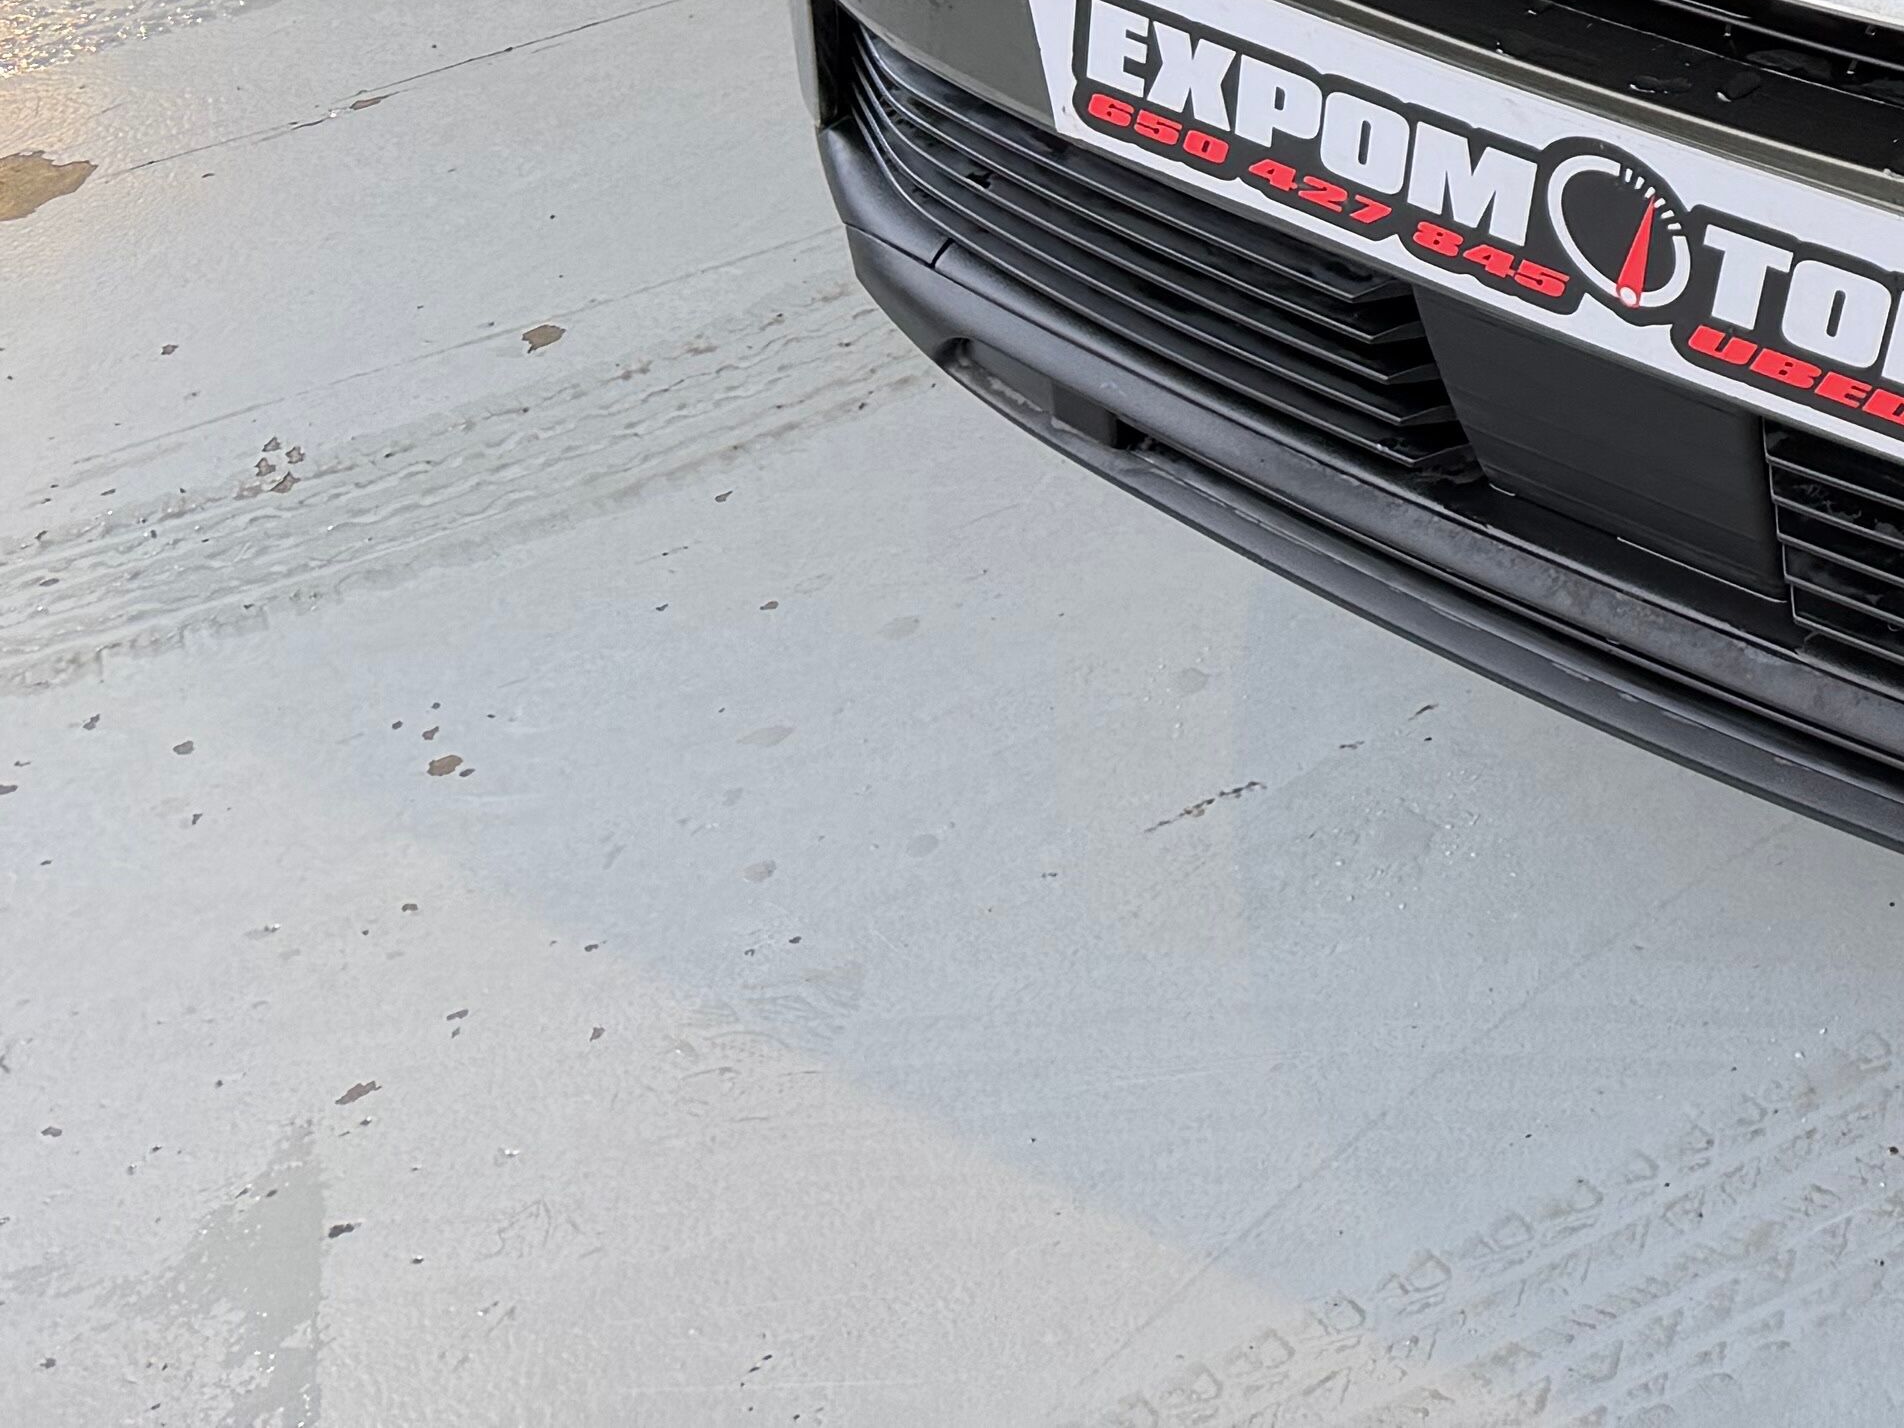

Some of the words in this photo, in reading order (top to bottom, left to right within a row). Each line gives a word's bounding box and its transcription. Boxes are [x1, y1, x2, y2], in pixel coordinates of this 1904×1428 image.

[1087, 91, 1229, 166] 650
[1248, 157, 1392, 226] 427
[1412, 221, 1571, 299] 845
